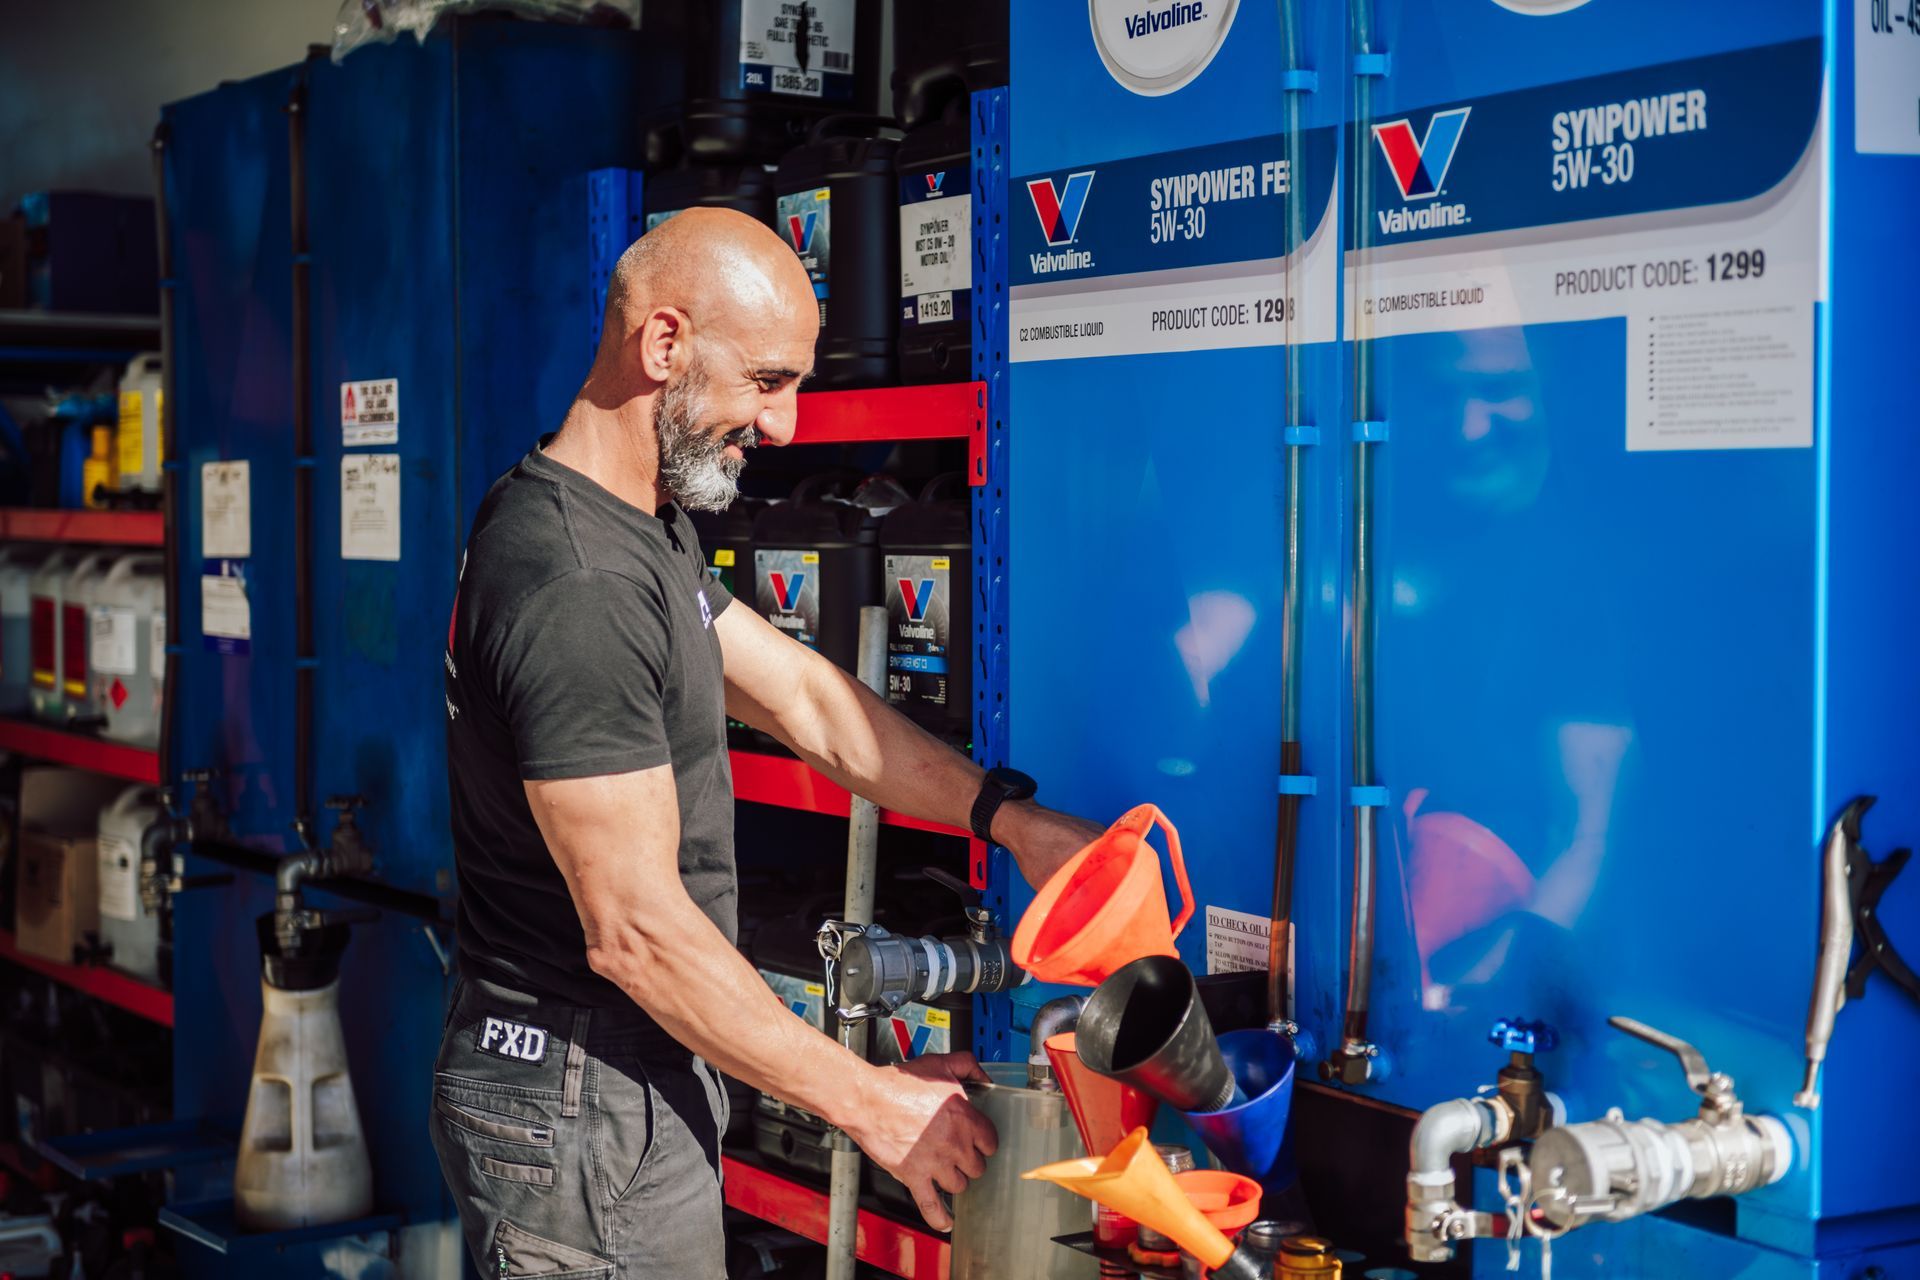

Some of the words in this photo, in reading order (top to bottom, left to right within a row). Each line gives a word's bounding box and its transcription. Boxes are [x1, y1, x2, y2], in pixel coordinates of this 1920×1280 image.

[1125, 2, 1202, 39] Valvoline
[1552, 89, 1707, 152] SYNPOWER
[1552, 142, 1634, 192] 5W-30
[1150, 164, 1255, 211] SYNPOWER
[1262, 159, 1290, 195] FE
[1150, 206, 1206, 244] 5W-30
[1378, 202, 1467, 235] Valvoline
[1030, 249, 1092, 274] Valvoline
[1555, 264, 1635, 297] PRODUCT
[1643, 259, 1698, 288] CODE:
[1706, 249, 1765, 282] 1299
[920, 299, 951, 318] 1419.20
[1378, 291, 1447, 313] COMBUSTIBLE
[1450, 287, 1484, 306] LIQUID
[1019, 328, 1029, 341] C2
[1030, 323, 1079, 341] COMBUSTIBLE
[1080, 321, 1104, 337] LIQUID
[1152, 307, 1208, 331] PRODUCT
[1211, 303, 1249, 328] CODE:
[899, 624, 934, 639] Valvoline
[889, 674, 911, 693] 5W-30
[1209, 913, 1220, 925] TO
[1221, 917, 1248, 933] CHECK
[1249, 923, 1264, 936] OIL
